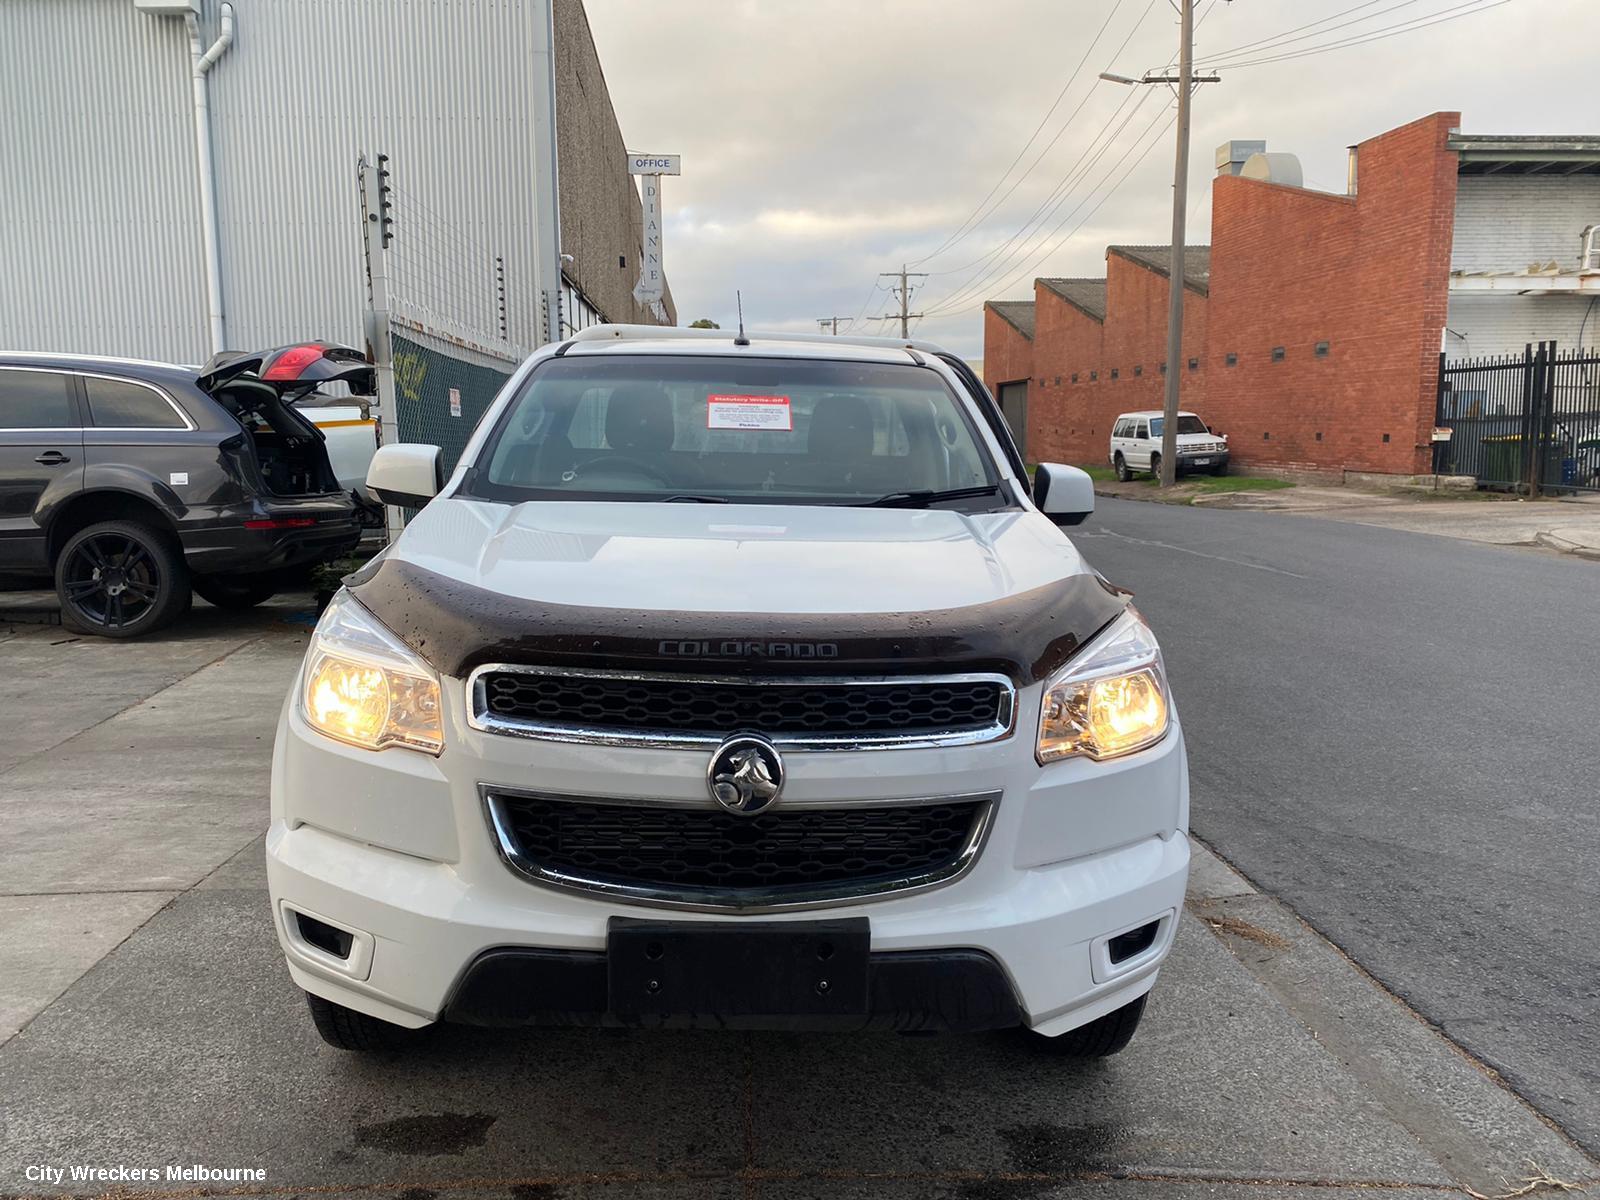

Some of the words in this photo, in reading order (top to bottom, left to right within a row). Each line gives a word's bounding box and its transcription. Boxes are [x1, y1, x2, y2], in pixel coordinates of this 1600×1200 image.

[636, 159, 670, 168] OFFICE
[647, 187, 659, 280] DIANNE
[658, 641, 839, 657] COLORADO
